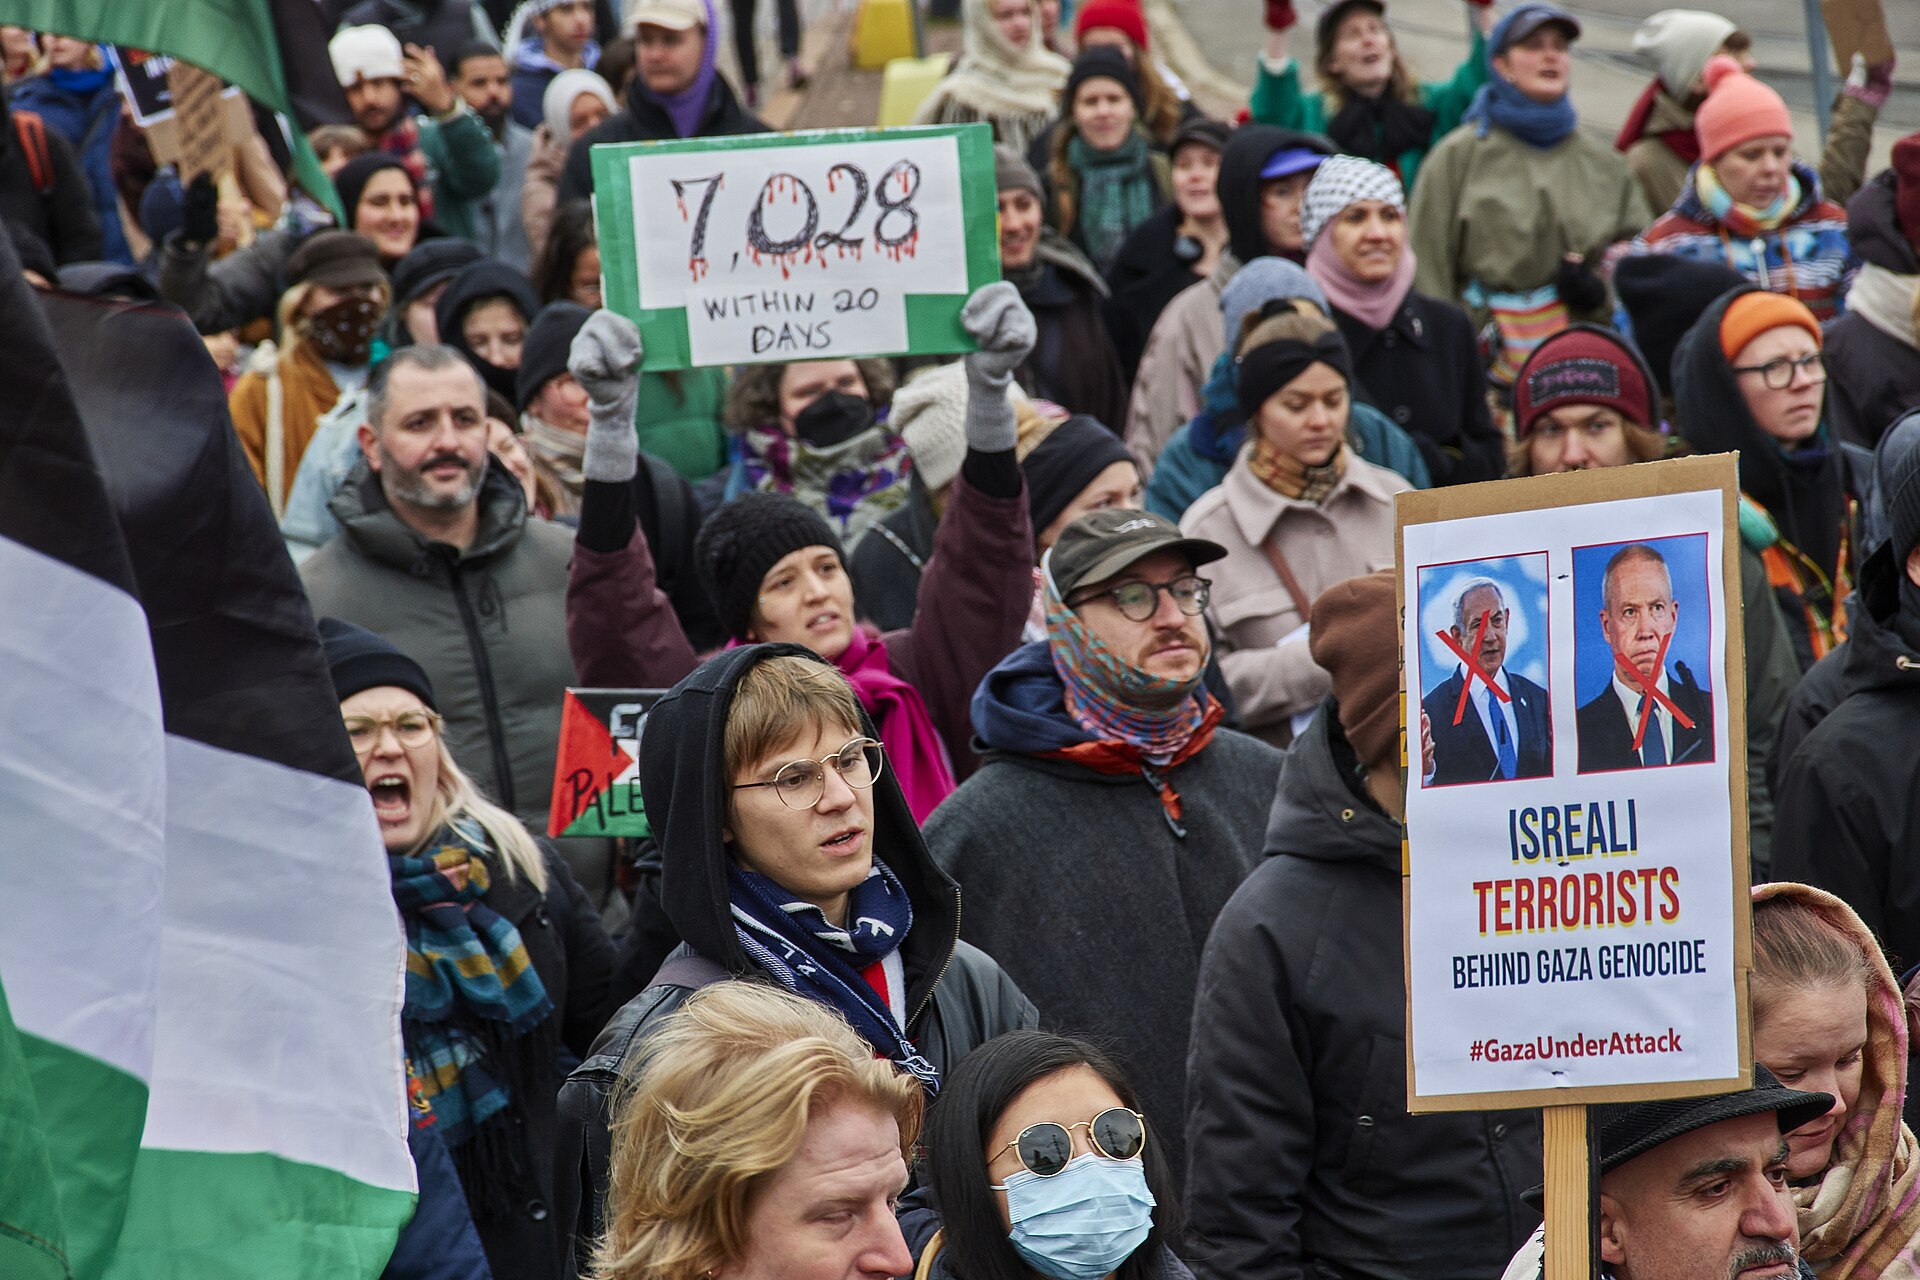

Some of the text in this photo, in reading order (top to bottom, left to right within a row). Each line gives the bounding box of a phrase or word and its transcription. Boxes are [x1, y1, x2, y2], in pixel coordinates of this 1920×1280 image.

[670, 159, 920, 282] 7,028
[704, 287, 879, 320] WITHIN 20
[752, 319, 832, 354] DAYS
[1510, 799, 1637, 863] ISREALI
[1473, 866, 1680, 936] TERRORISTS
[1453, 940, 1706, 989] BEHIND GAZA GENOCIDE
[1470, 1028, 1682, 1062] #GazaUnderAttack
